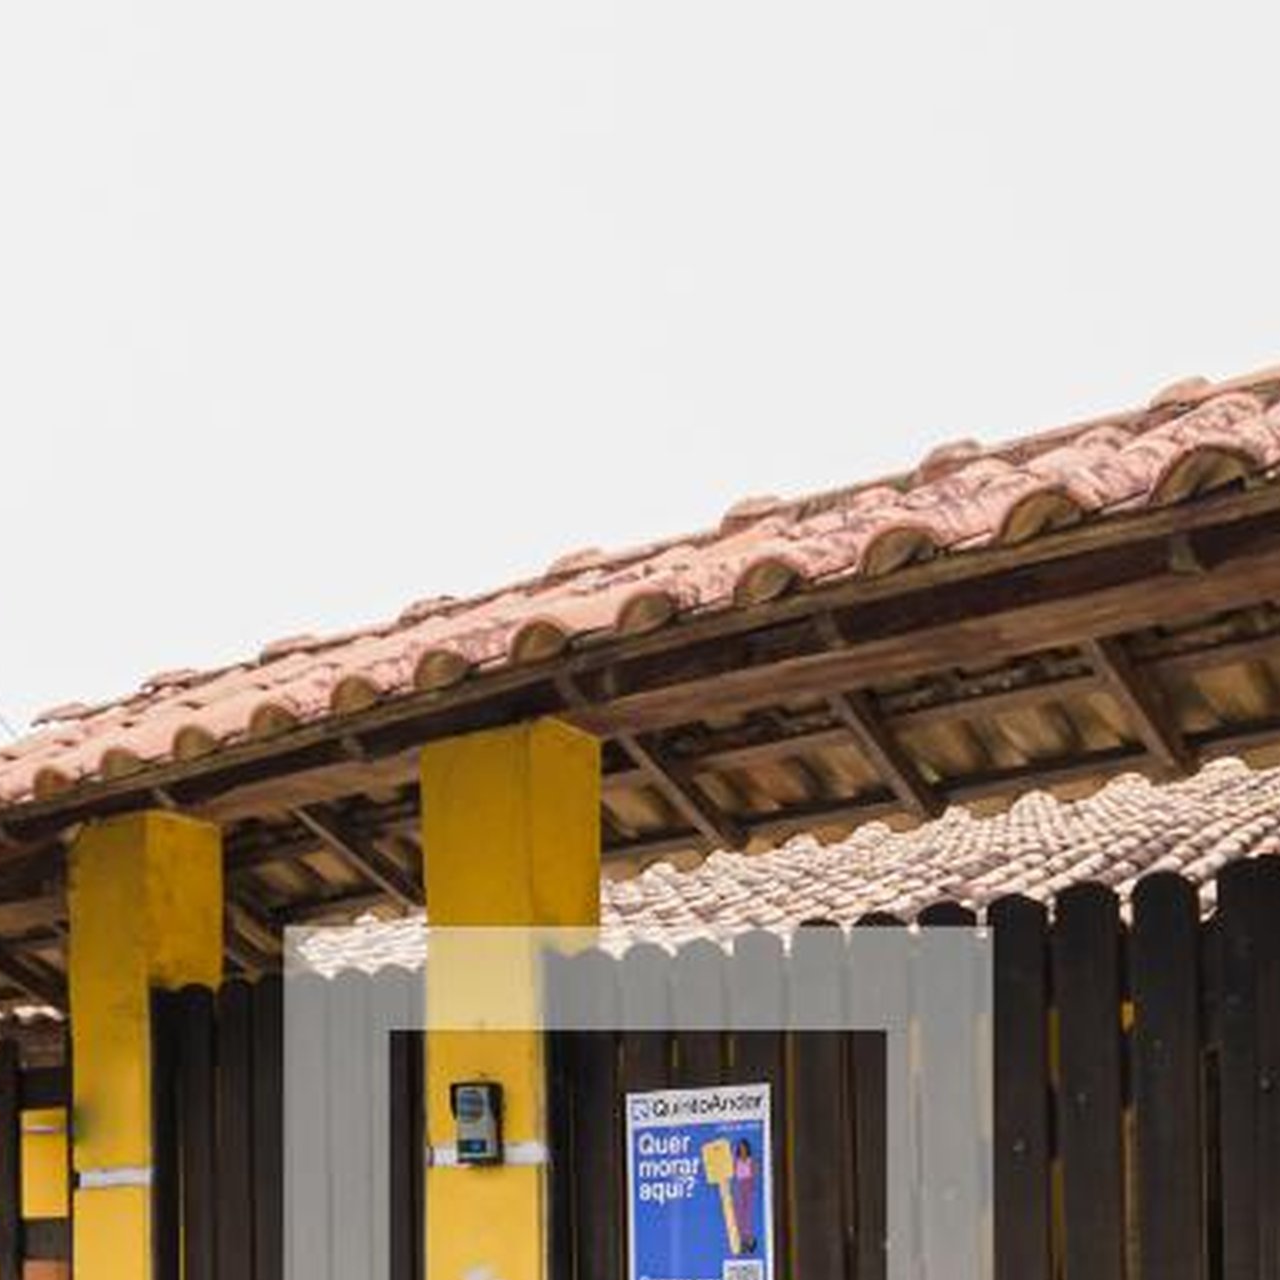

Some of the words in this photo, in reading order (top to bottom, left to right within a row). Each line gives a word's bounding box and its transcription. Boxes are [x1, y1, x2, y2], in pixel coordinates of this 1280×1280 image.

[639, 1133, 691, 1155] Quer
[639, 1157, 699, 1178] morar
[639, 1178, 695, 1205] aqui?
